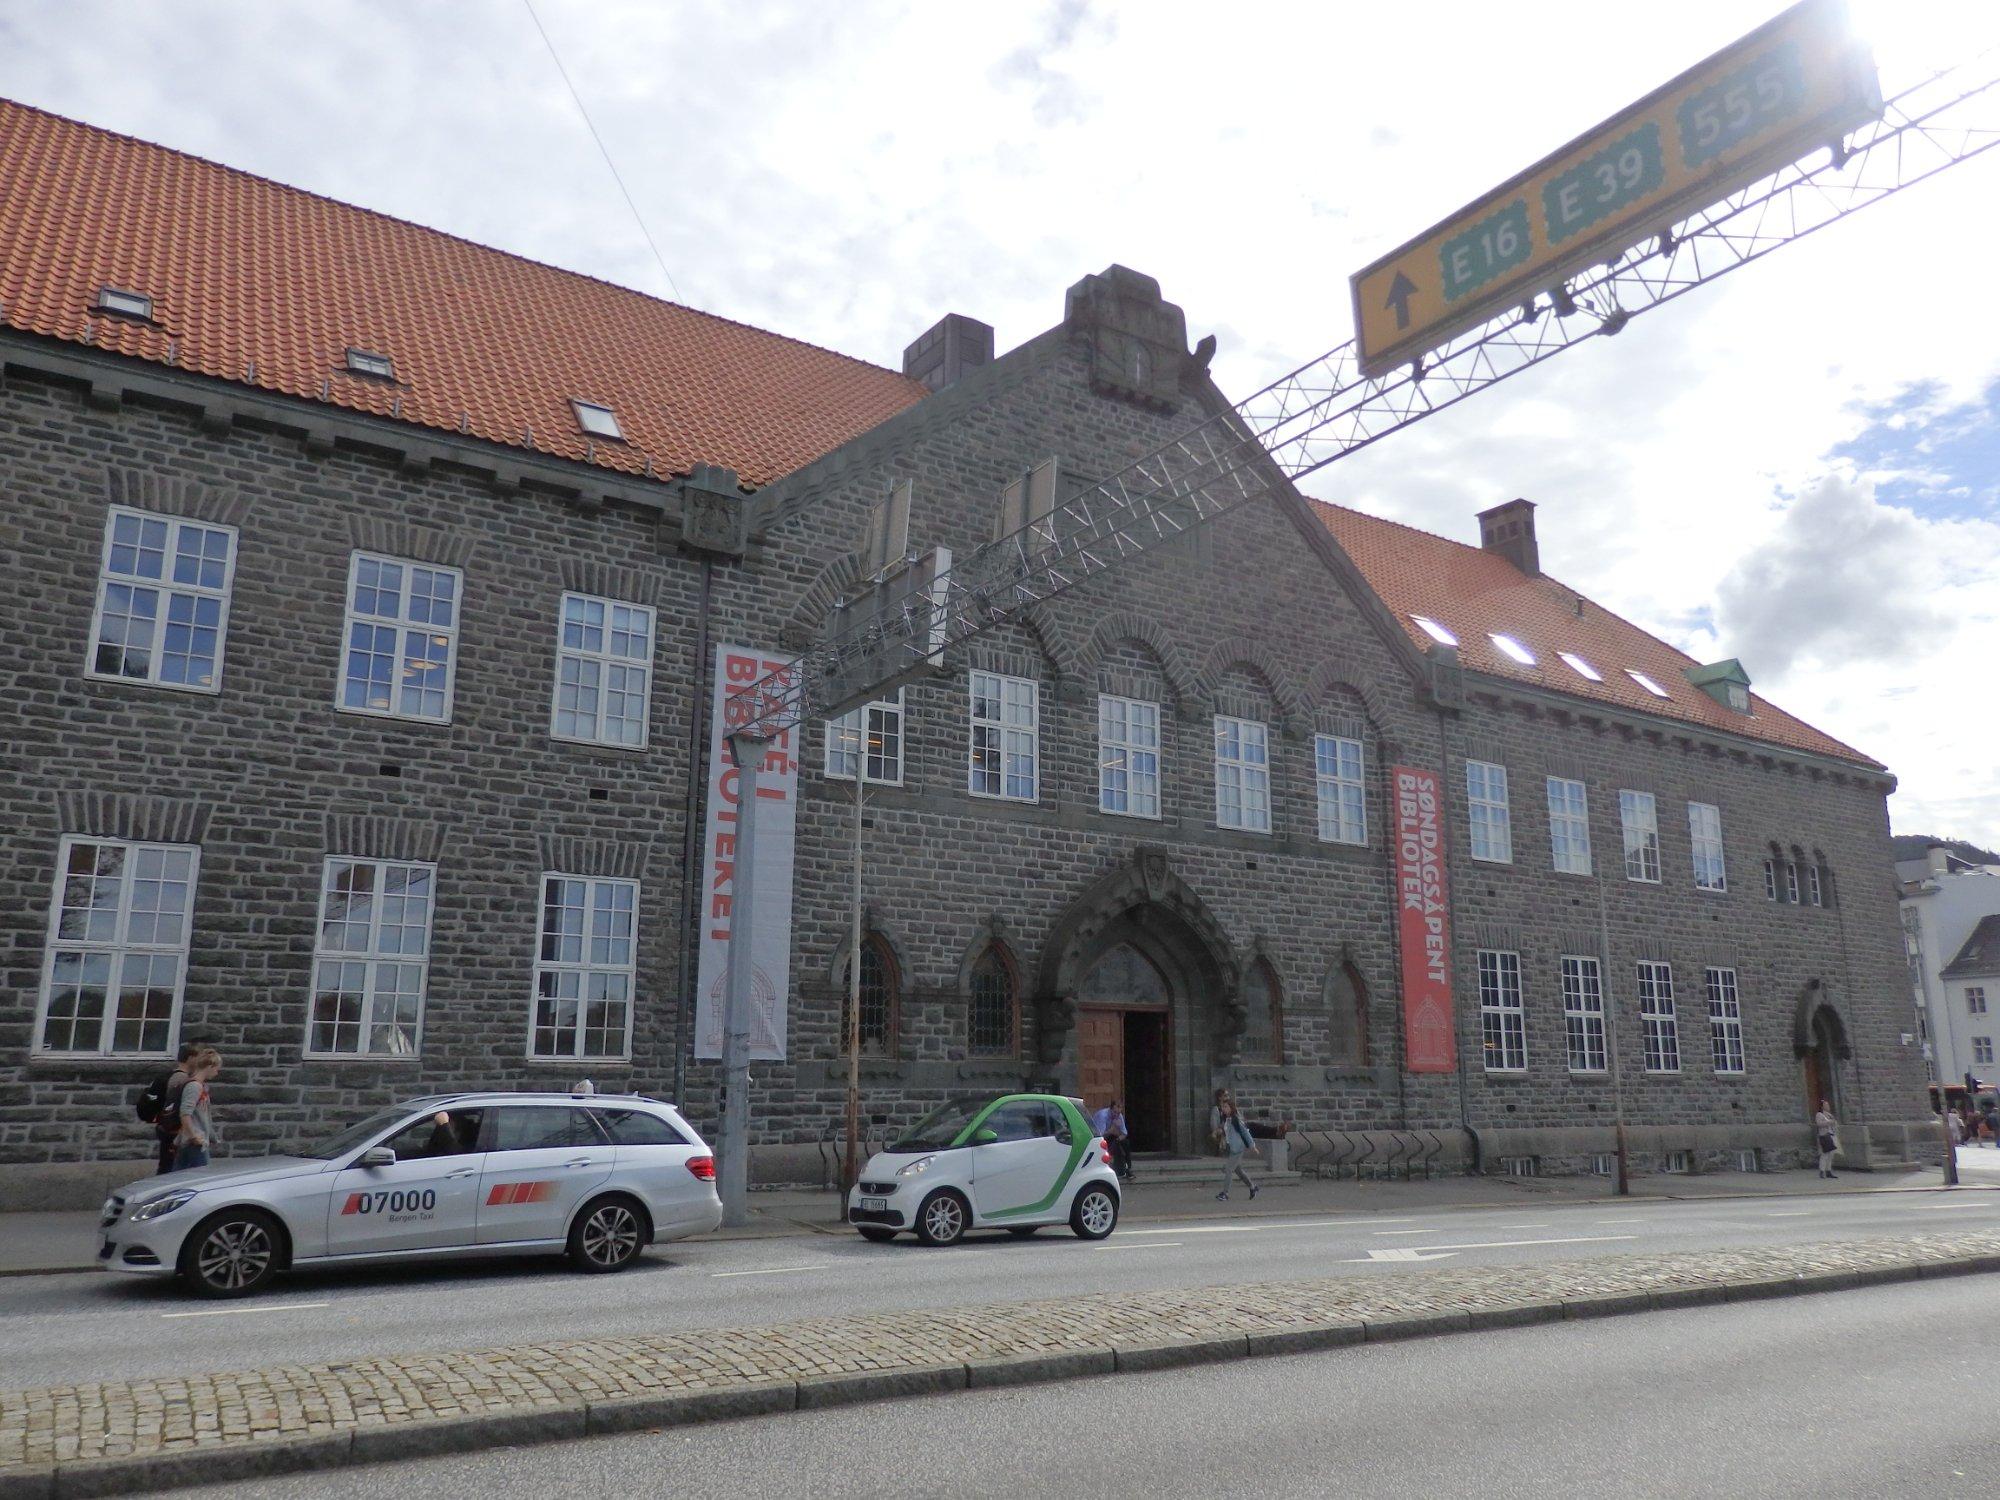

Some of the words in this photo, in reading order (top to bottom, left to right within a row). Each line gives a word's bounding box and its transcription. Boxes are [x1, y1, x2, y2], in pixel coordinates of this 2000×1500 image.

[1695, 66, 1783, 147] 555
[1559, 181, 1583, 224] E
[1594, 149, 1643, 202] 39
[1452, 245, 1472, 284] E
[1481, 220, 1518, 266] 16
[1398, 774, 1423, 911] BIBLIOTEK
[1417, 776, 1445, 985] SØNDAGSÅPENT
[359, 1189, 436, 1214] 07000
[389, 1214, 417, 1223] Bergen
[420, 1212, 434, 1220] Taxi
